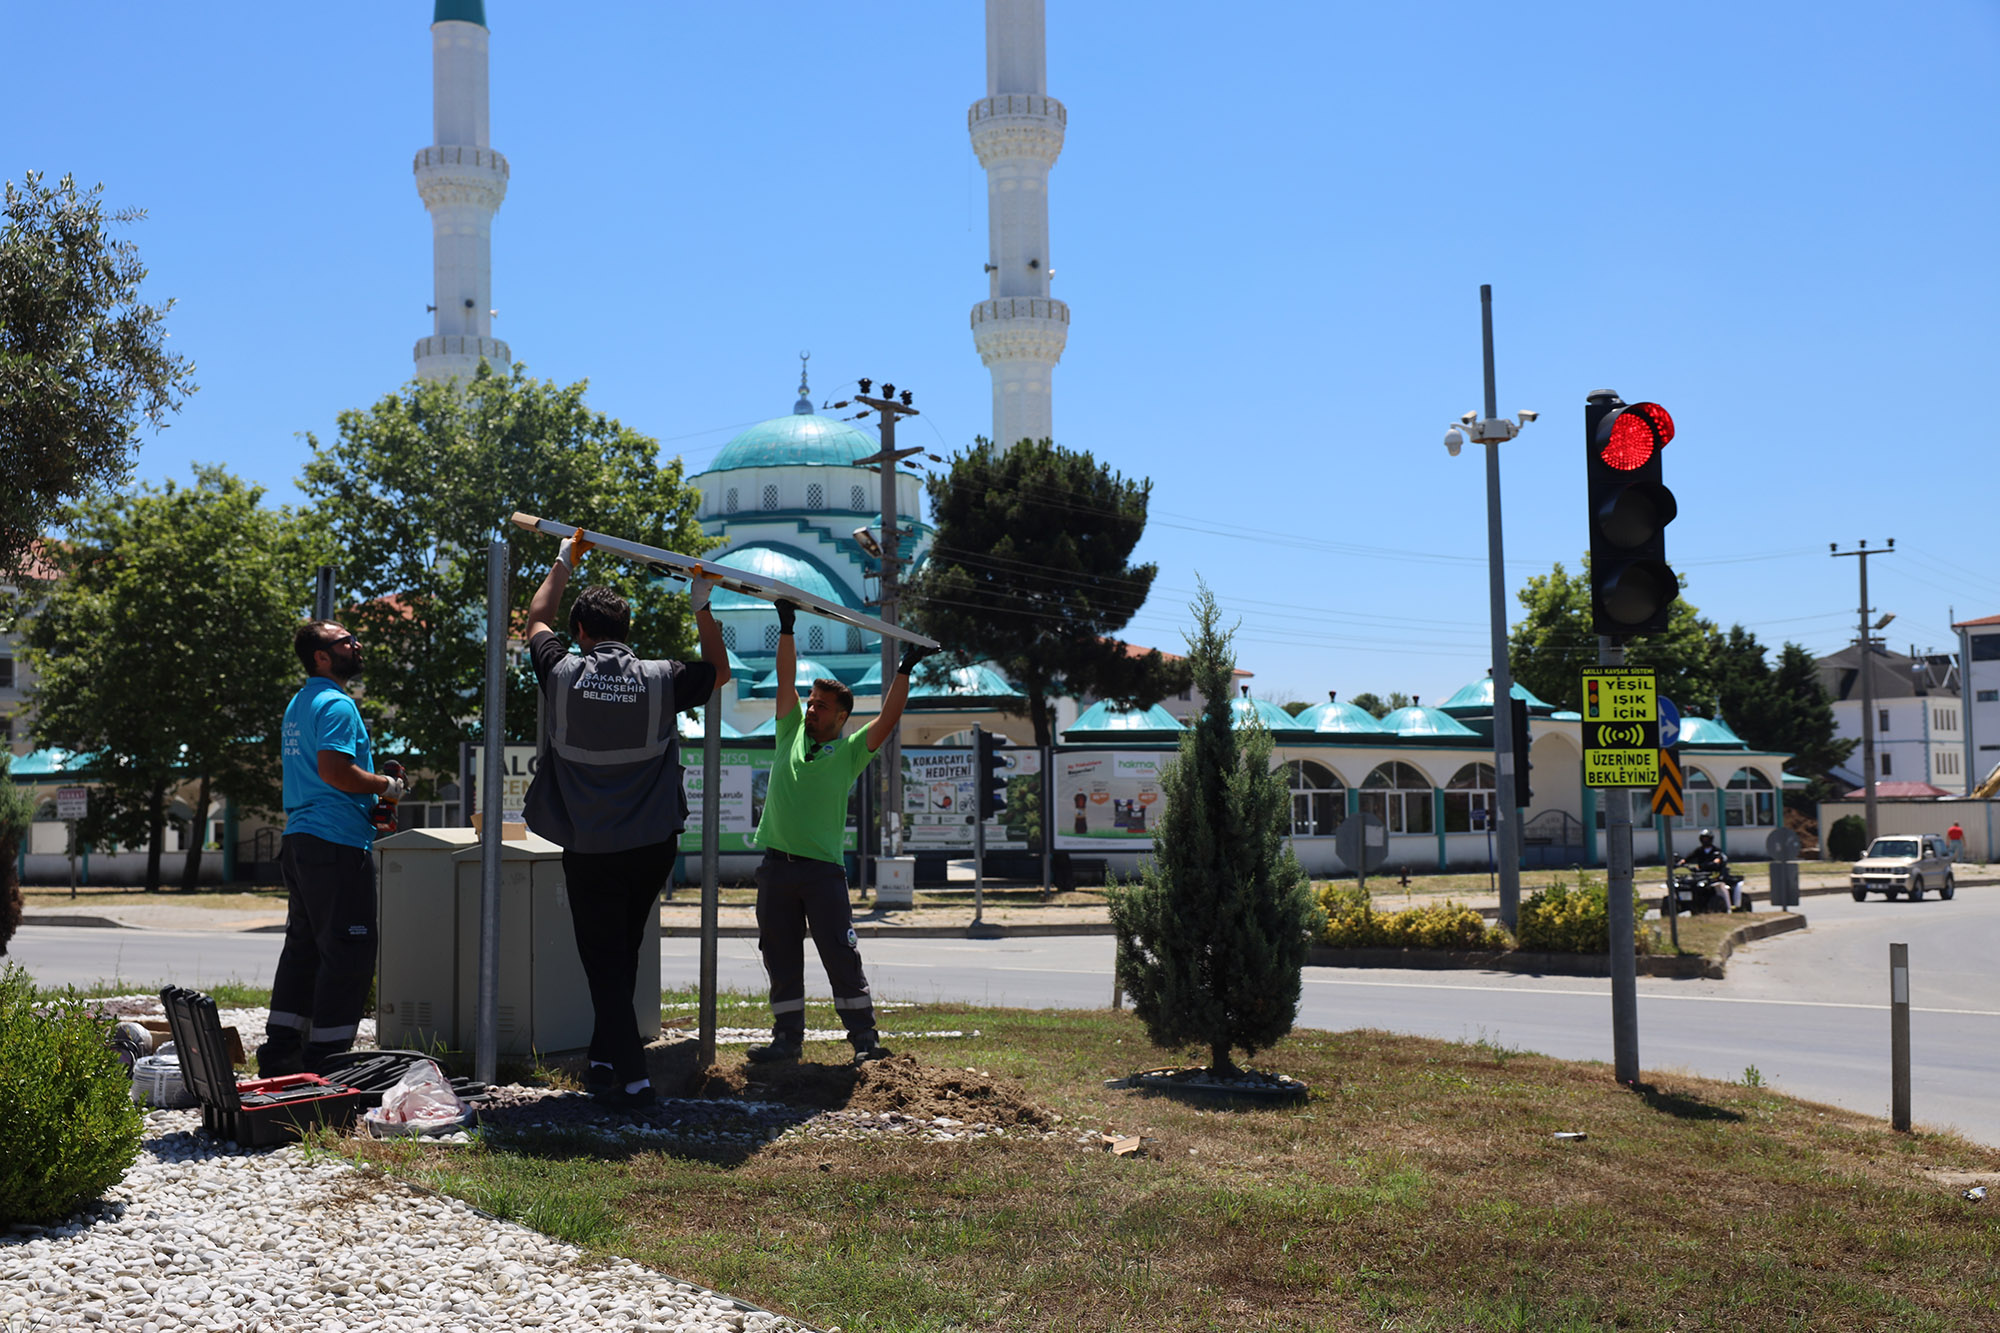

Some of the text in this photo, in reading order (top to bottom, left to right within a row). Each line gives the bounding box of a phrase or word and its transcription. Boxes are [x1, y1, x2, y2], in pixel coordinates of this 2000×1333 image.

[584, 672, 636, 684] SAKARYA
[1606, 678, 1652, 690] YEŞİL
[576, 680, 646, 692] BÜYÜKŞEHİR
[582, 690, 636, 703] BELEDİYESİ
[1614, 695, 1646, 705] IŞIK
[1614, 707, 1646, 719] İÇİN
[1592, 750, 1651, 766] ÜZERİNDE
[1588, 768, 1656, 783] BEKLEYİNİZ
